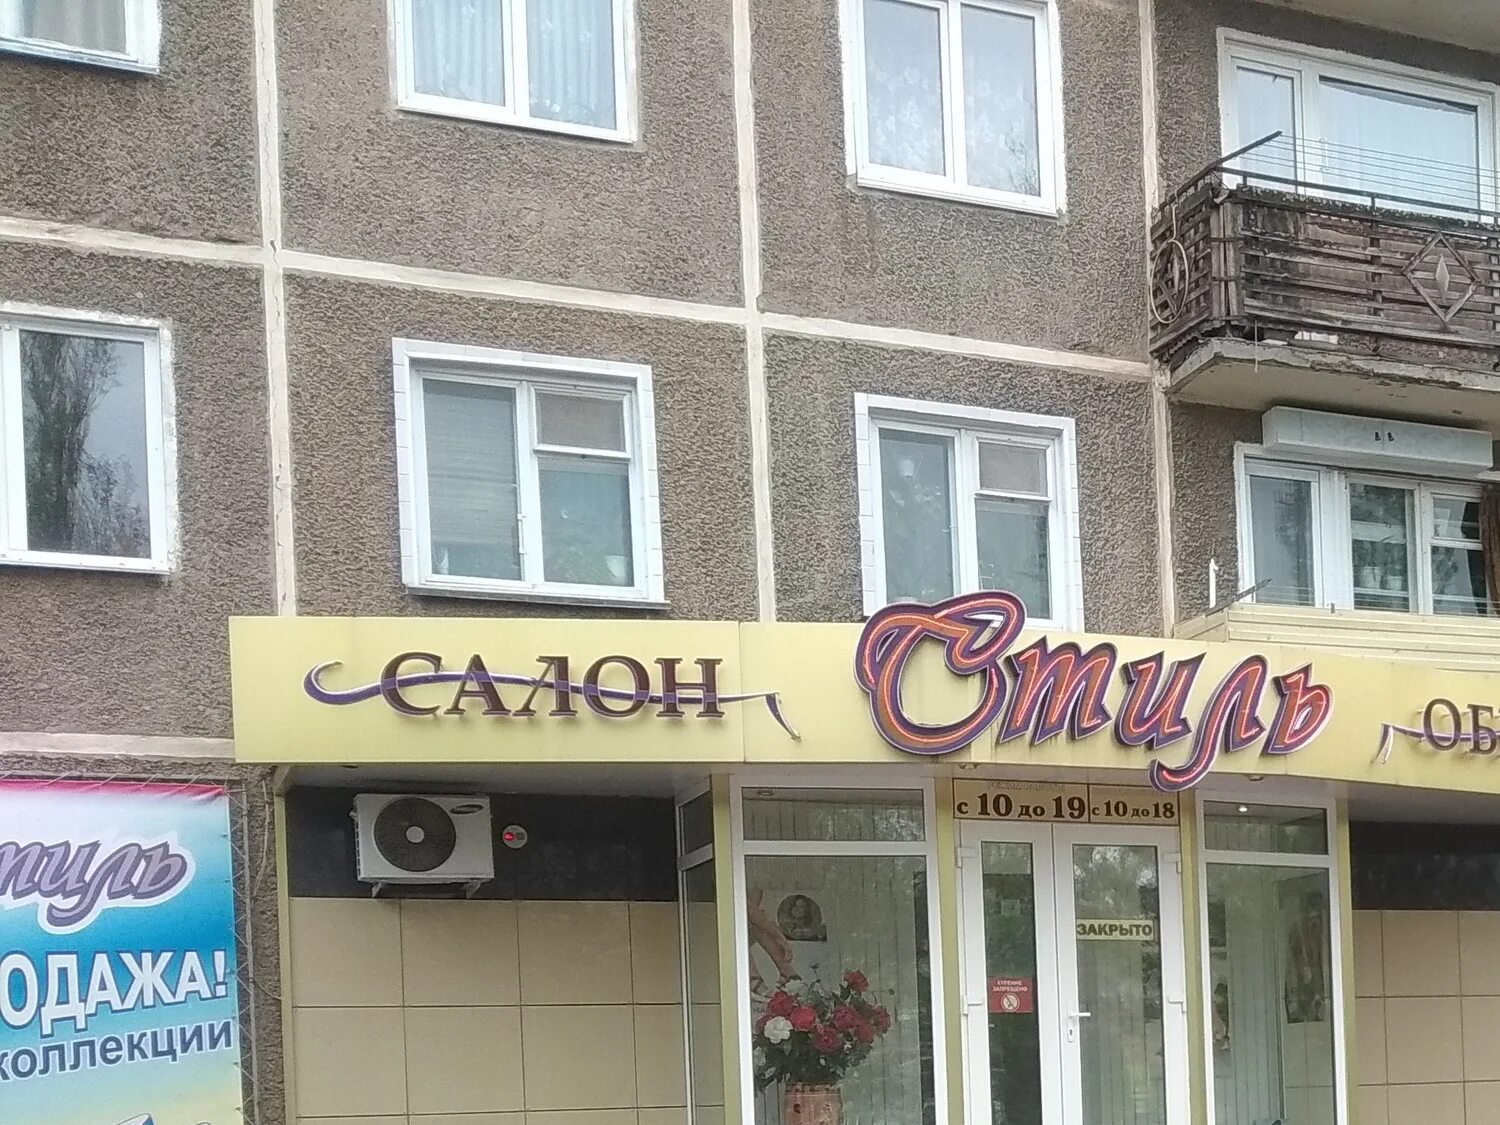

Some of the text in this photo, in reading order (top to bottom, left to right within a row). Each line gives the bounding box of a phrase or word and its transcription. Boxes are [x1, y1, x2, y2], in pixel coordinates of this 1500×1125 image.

[380, 651, 725, 718] САЛОН
[855, 590, 1334, 792] Стиль
[957, 793, 1086, 819] с 10 до 19
[1092, 800, 1175, 819] с 10 до 18
[1076, 924, 1152, 936] ЗАКРЫТО
